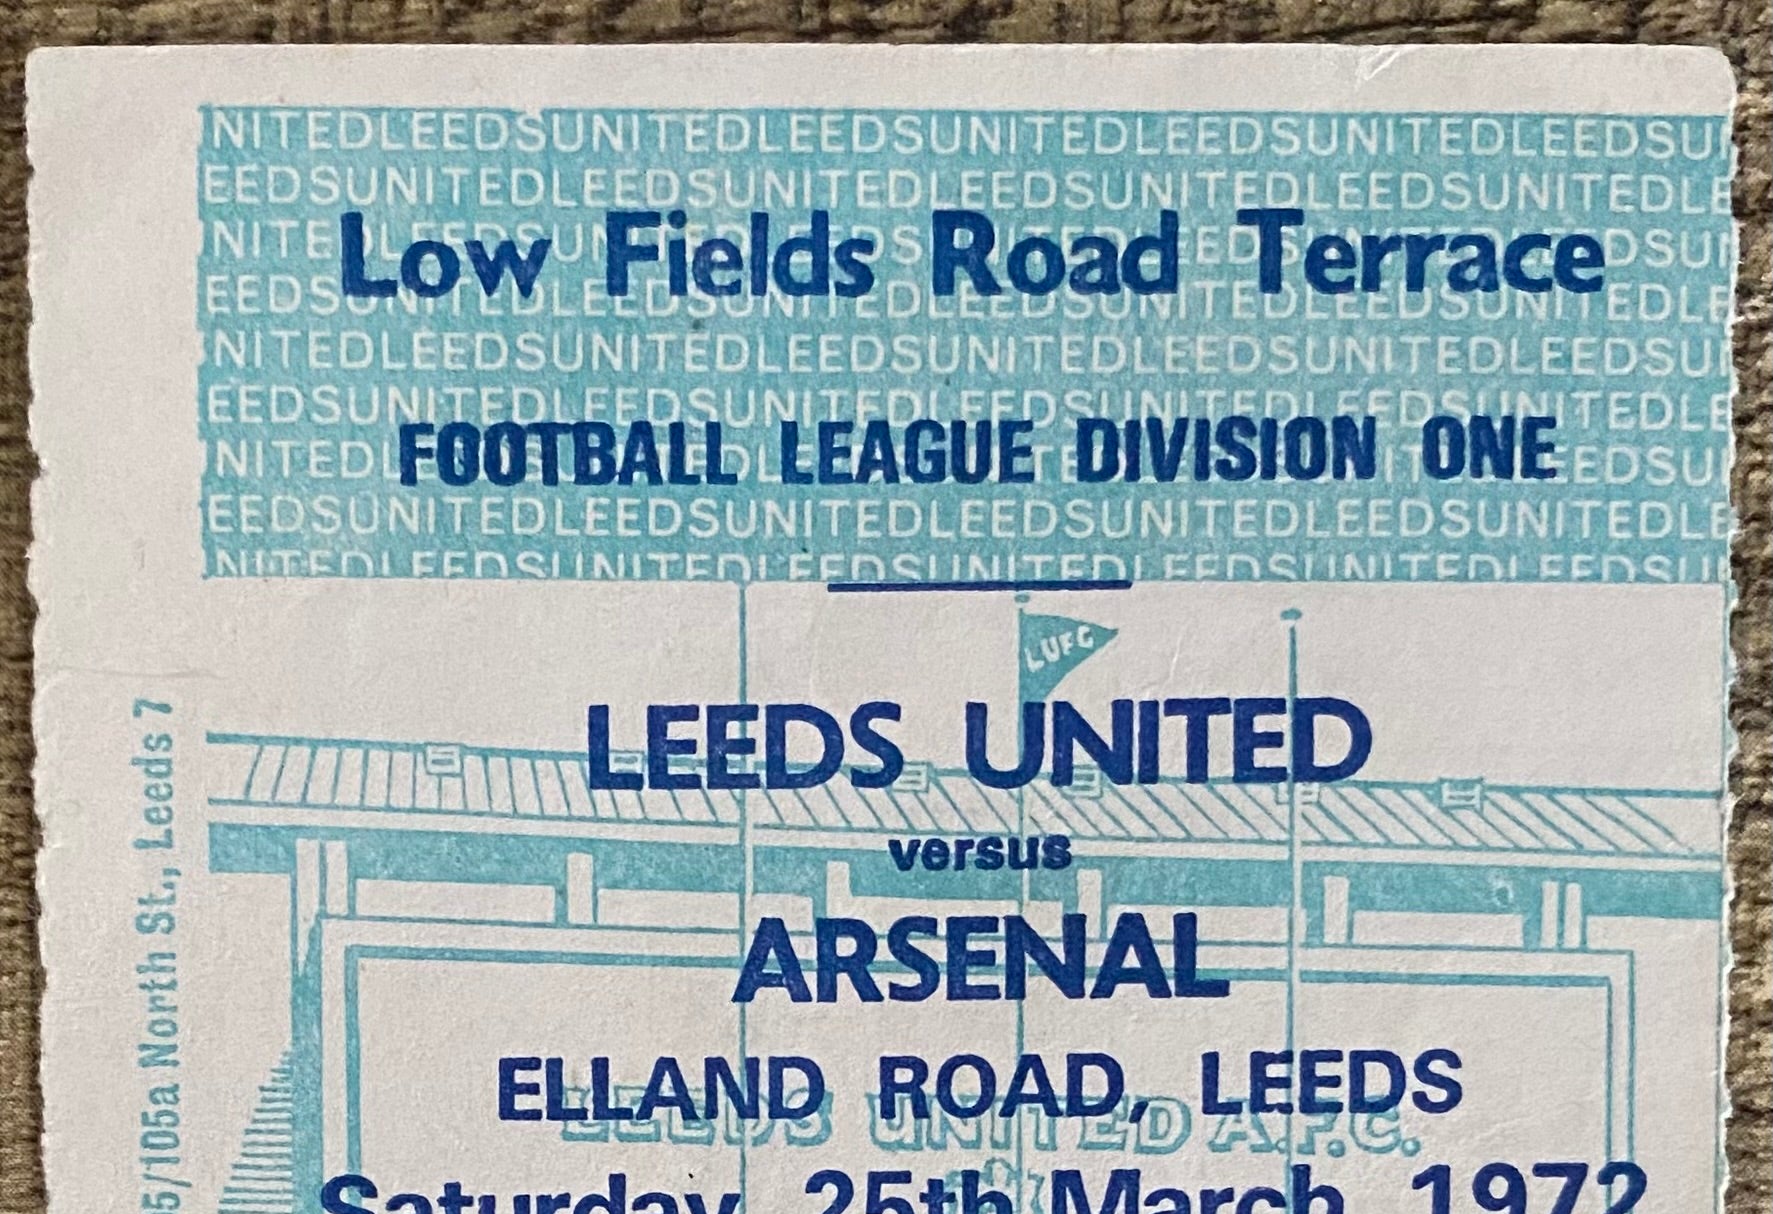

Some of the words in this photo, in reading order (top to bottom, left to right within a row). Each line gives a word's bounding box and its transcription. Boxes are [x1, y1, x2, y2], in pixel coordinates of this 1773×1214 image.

[342, 211, 551, 298] Low
[607, 209, 875, 298] Fields
[933, 209, 1179, 298] Road
[1237, 208, 1604, 294] Terrace
[399, 420, 737, 486] FOOTBALL
[781, 419, 1034, 486] LEAGUE
[1076, 415, 1377, 482] DIVISION
[1423, 415, 1557, 480] ONE
[1024, 624, 1094, 673] LUFC
[132, 698, 173, 718] 7
[587, 701, 904, 791] LEEDS
[965, 697, 1372, 790] UNITED
[131, 733, 173, 850] Leeds
[888, 834, 1073, 871] versus
[134, 867, 182, 934] St.,
[732, 912, 1230, 1003] ARSENAL
[137, 951, 179, 1068] North
[498, 1056, 826, 1121] ELLAND
[878, 1052, 1149, 1124] ROAD,
[1202, 1048, 1464, 1116] LEEDS
